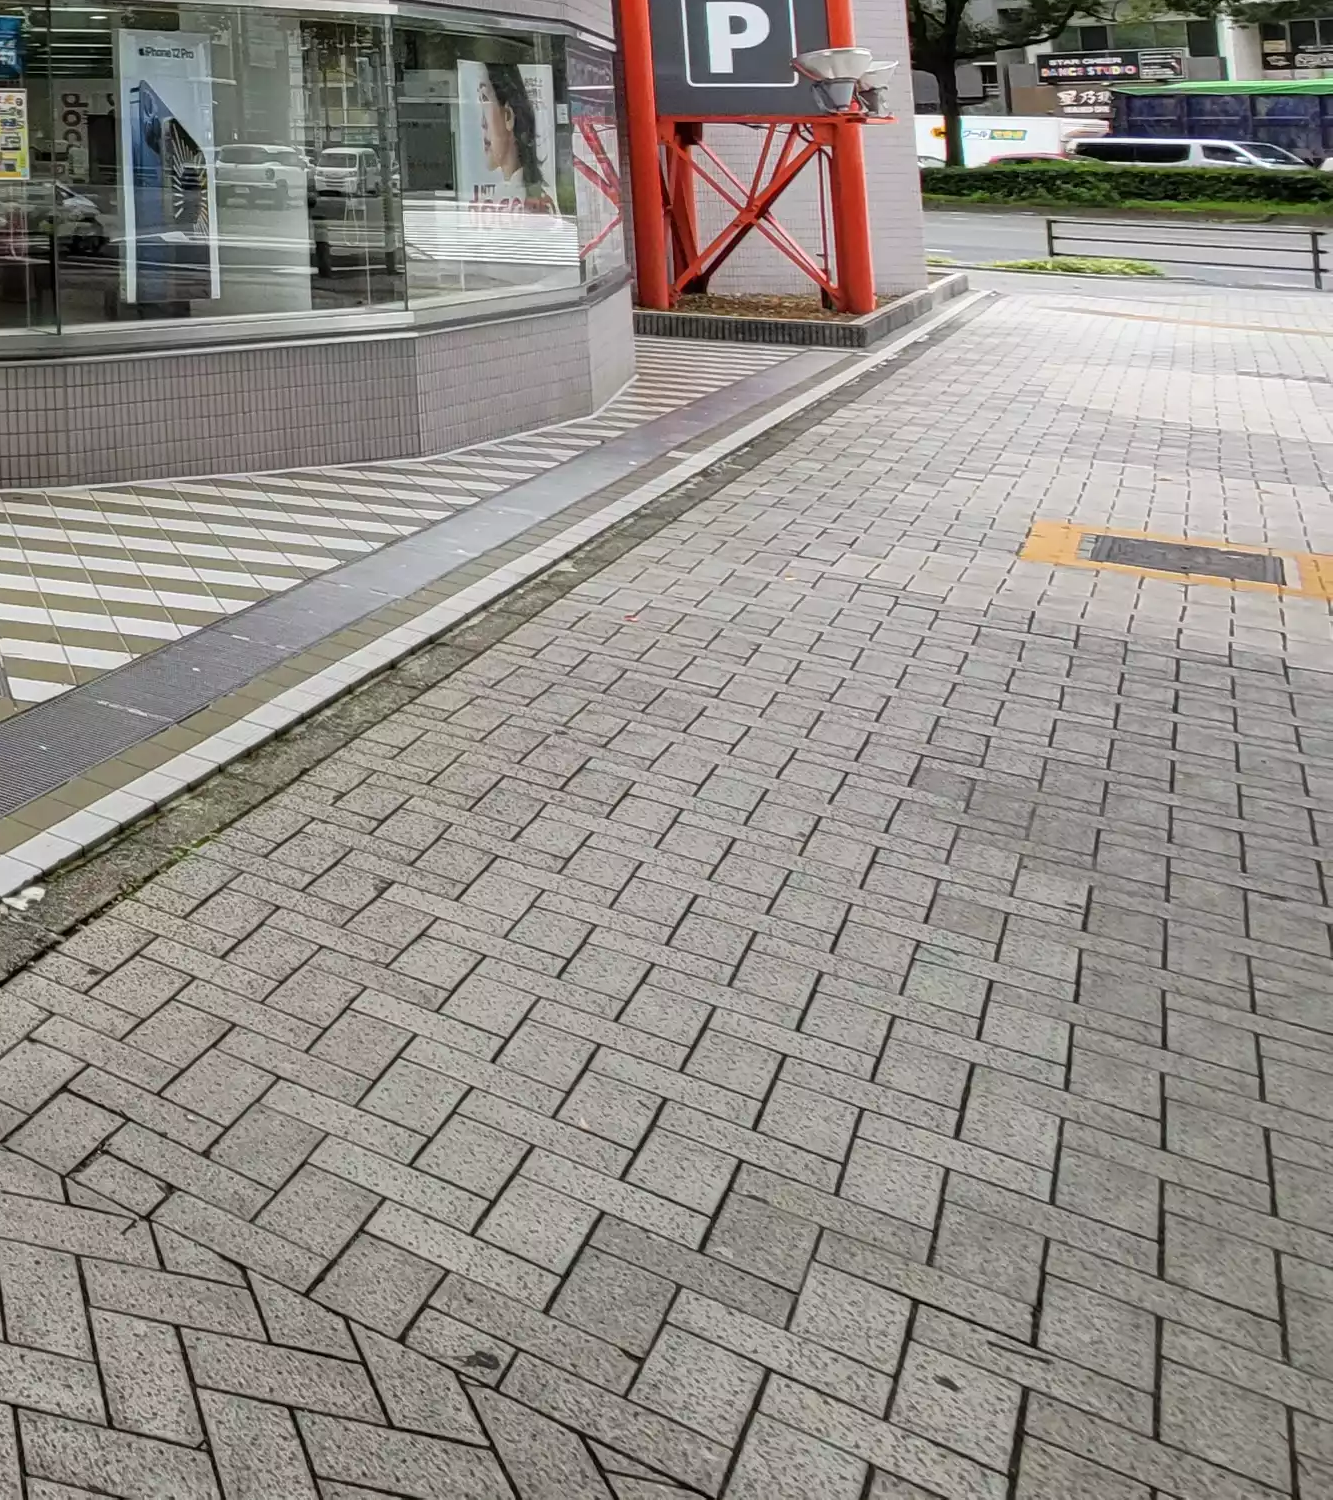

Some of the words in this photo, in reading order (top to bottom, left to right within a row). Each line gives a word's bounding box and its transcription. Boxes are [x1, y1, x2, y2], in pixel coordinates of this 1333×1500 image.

[706, 1, 770, 73] P
[1040, 67, 1085, 77] DANCE
[1087, 65, 1138, 76] STUDIO
